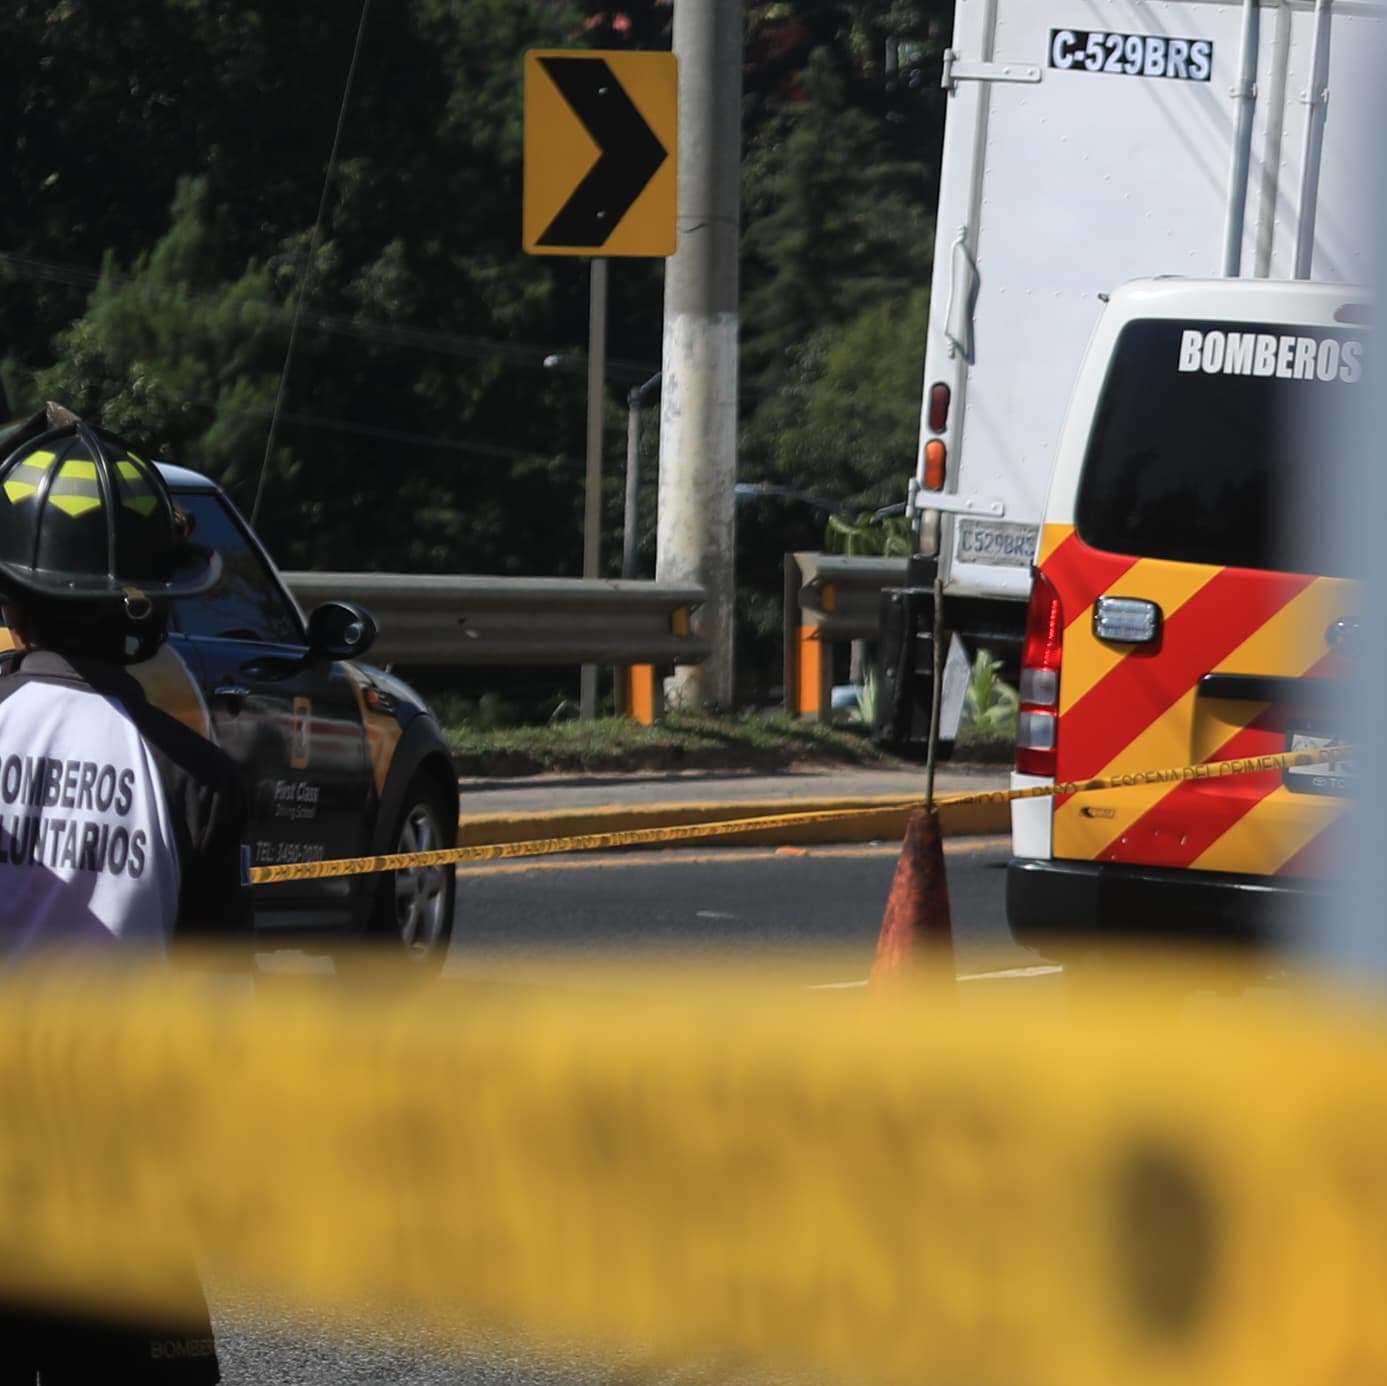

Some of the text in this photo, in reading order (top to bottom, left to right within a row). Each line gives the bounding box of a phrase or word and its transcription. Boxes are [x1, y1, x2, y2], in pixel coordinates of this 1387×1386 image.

[1051, 30, 1212, 80] C-529BRS
[1177, 329, 1364, 383] BOMBEROS
[0, 753, 136, 817] OMBEROS
[0, 814, 147, 879] LUNTARIOS
